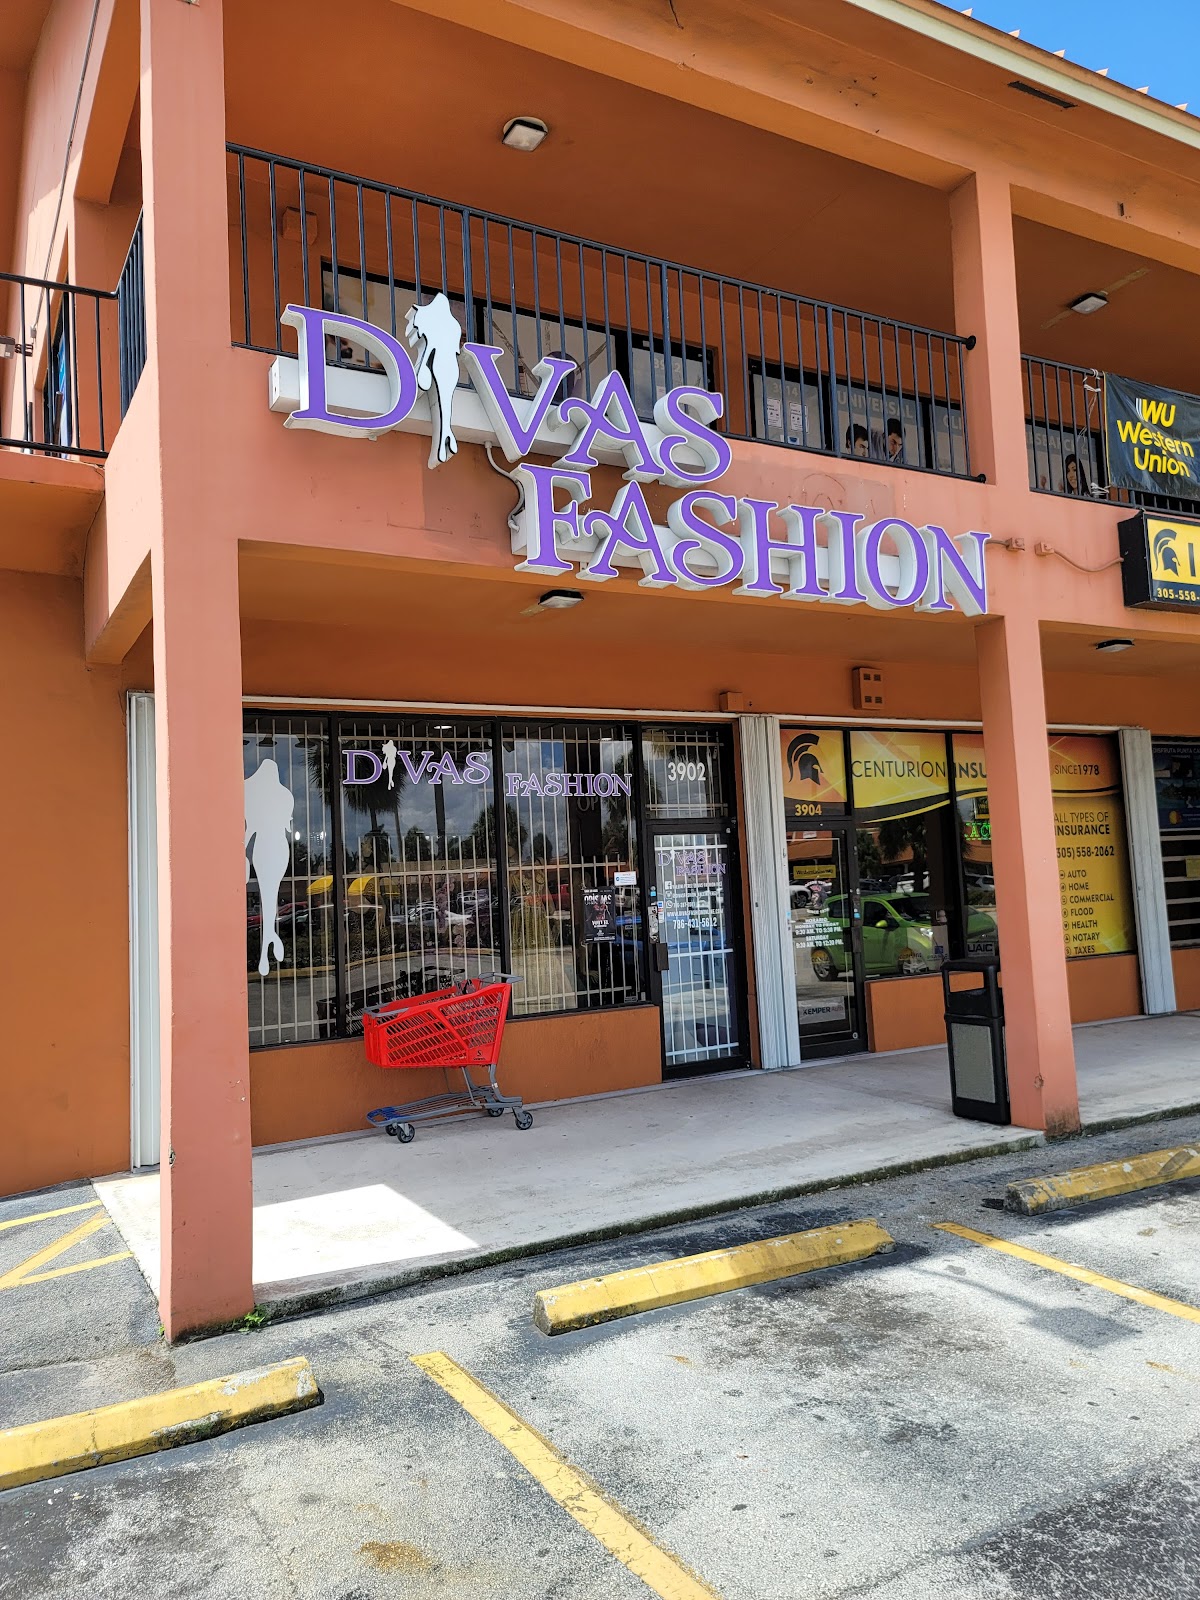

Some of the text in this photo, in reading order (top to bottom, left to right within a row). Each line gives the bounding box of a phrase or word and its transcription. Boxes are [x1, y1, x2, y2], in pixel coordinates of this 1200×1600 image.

[653, 358, 681, 373] 392
[773, 382, 799, 398] 314
[1136, 398, 1176, 428] WU
[943, 414, 962, 431] CLI
[1117, 420, 1195, 458] Western
[1133, 447, 1191, 478] Union
[514, 463, 992, 617] FASHION
[1156, 587, 1200, 602] 305-558-
[667, 761, 706, 782] 3902
[851, 760, 988, 779] CENTURION INSU
[505, 772, 632, 798] FASHION
[577, 796, 618, 812] OPN
[794, 803, 823, 817] 3904
[1054, 811, 1109, 823] ALL TYPES OF
[1054, 823, 1110, 836] INSURANCE
[1076, 845, 1115, 857] 558-2062
[1067, 869, 1087, 879] AUTO
[1068, 882, 1089, 891] HOME
[1069, 893, 1115, 904] COMMERCIAL
[1070, 907, 1094, 916] FLOOD
[1071, 919, 1098, 930] HEALTH
[1072, 931, 1101, 942] NOTARY
[967, 943, 993, 953] UAIC
[1074, 945, 1096, 955] TAXES
[803, 1006, 831, 1016] KEMPER
